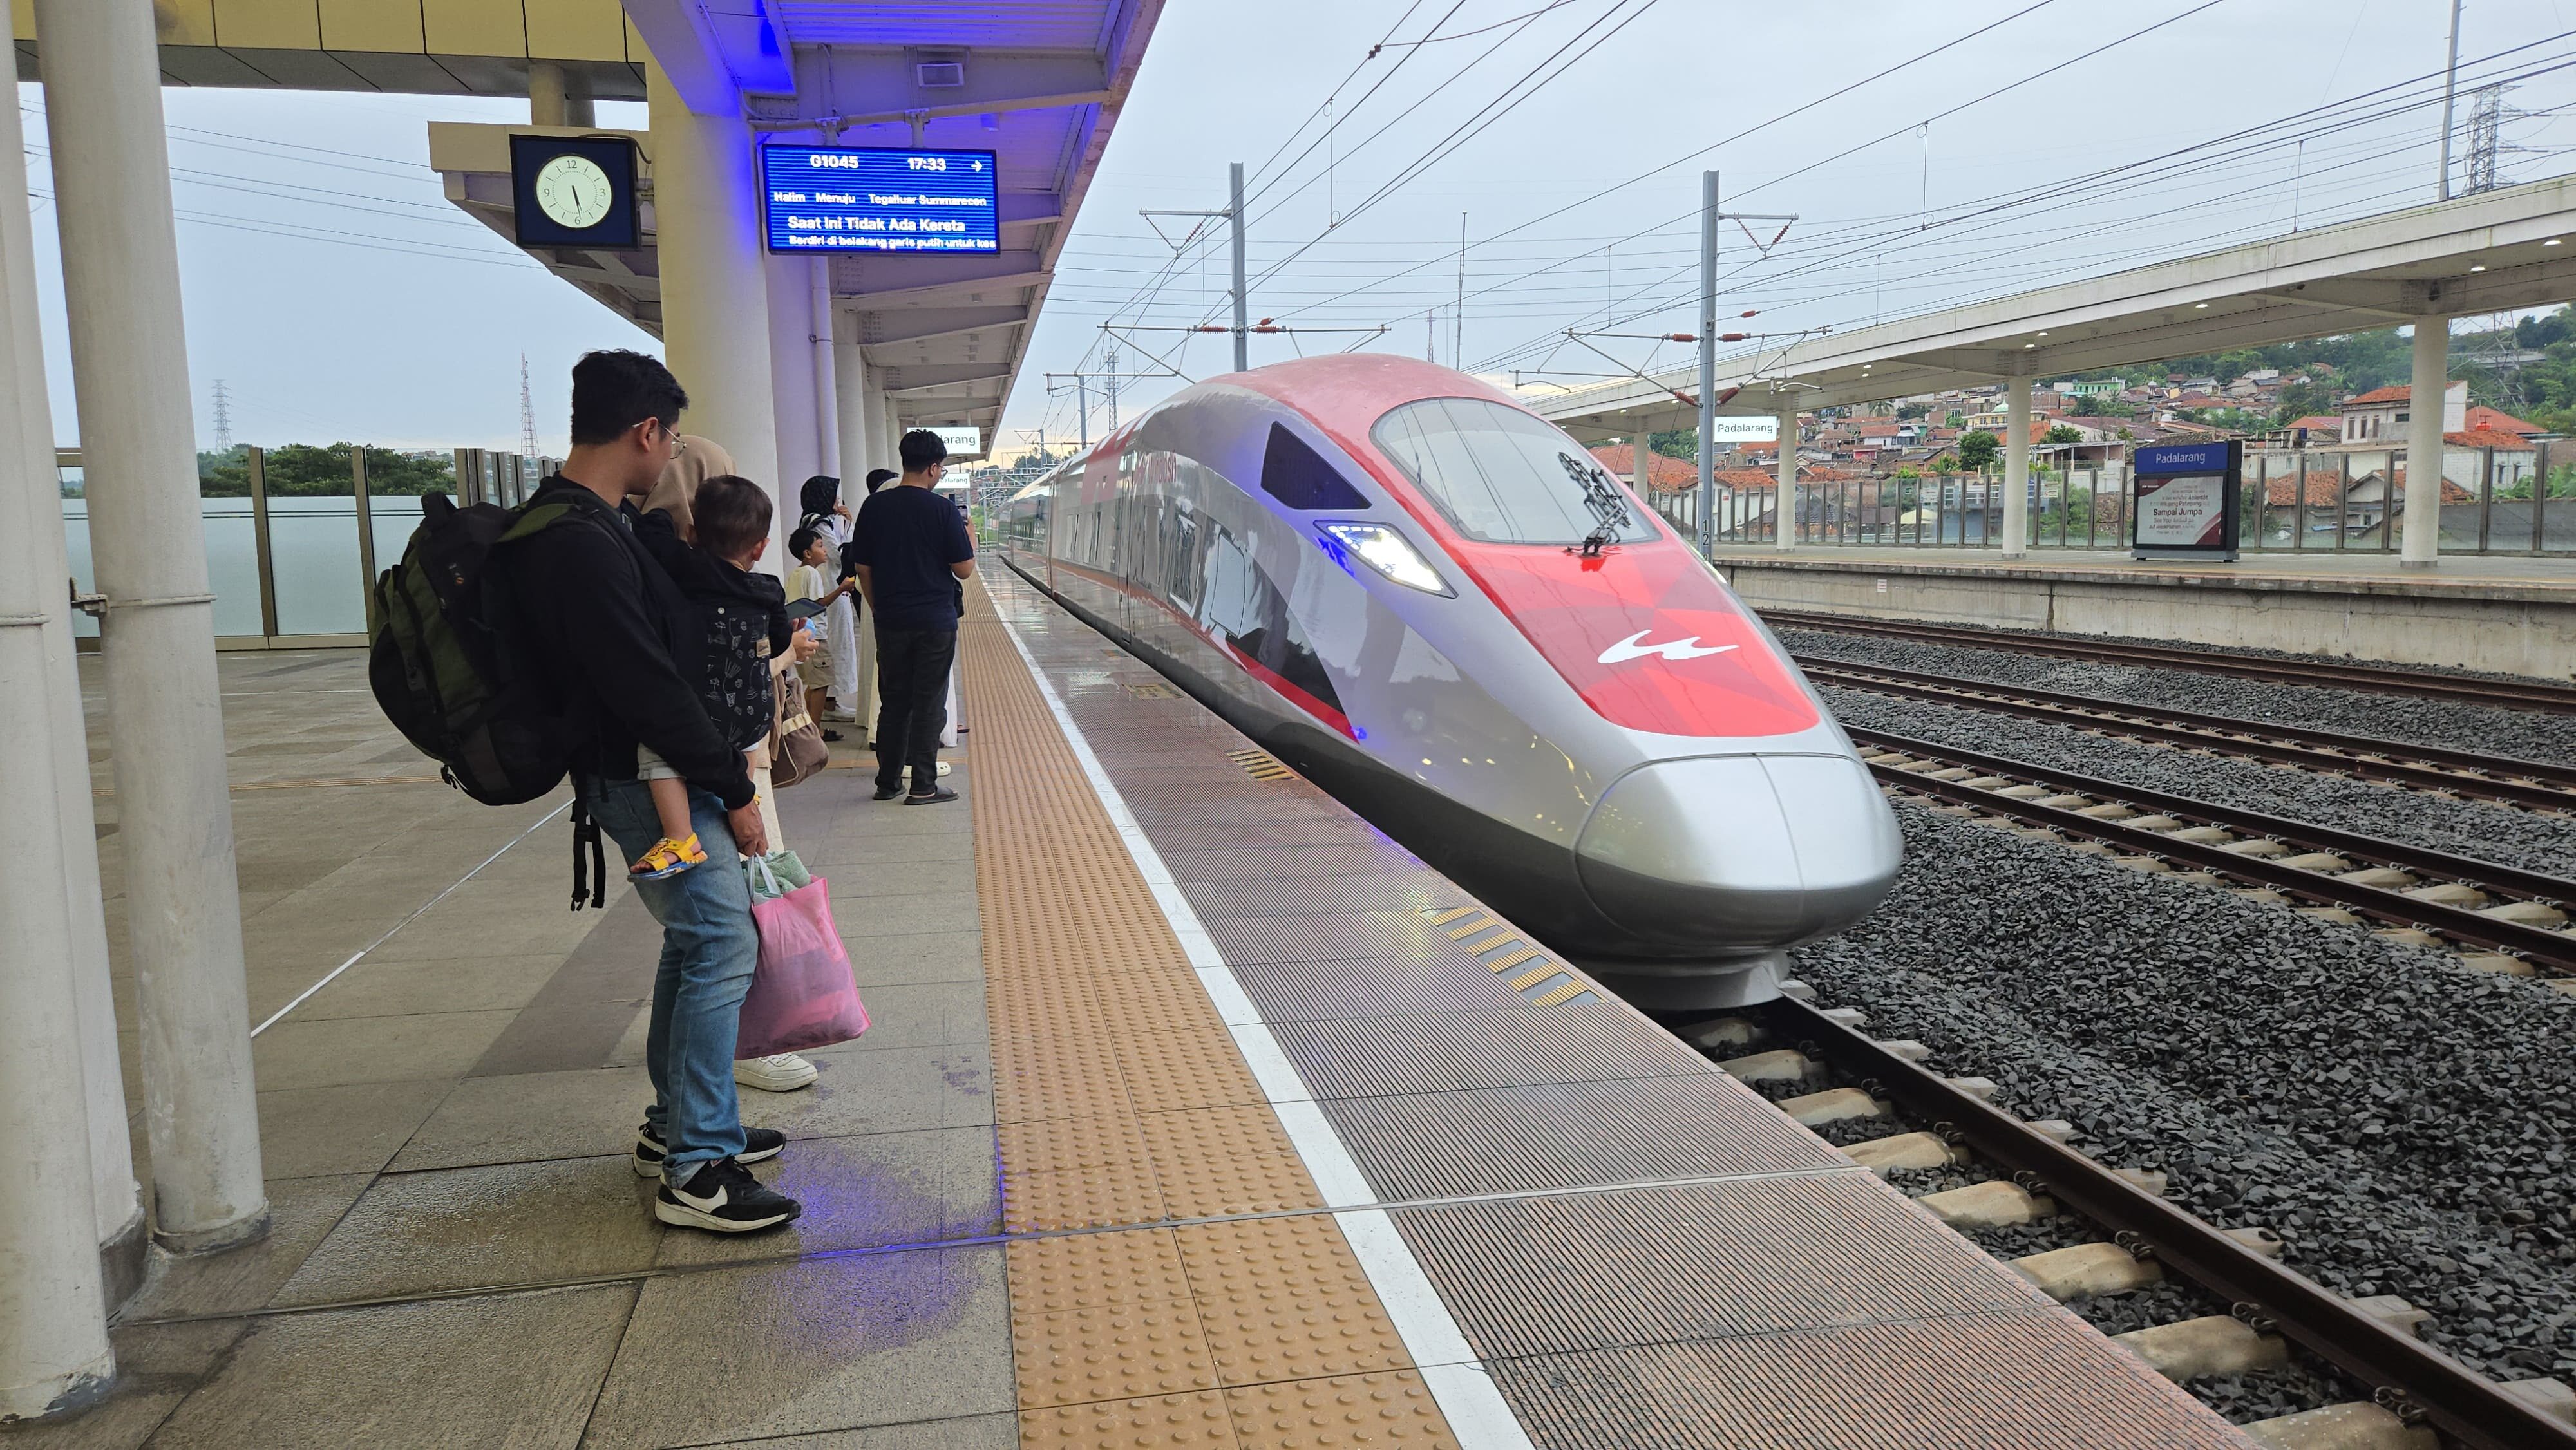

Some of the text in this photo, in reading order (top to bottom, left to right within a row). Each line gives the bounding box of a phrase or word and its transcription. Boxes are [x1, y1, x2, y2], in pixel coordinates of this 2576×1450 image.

[567, 160, 577, 169] 12
[810, 155, 947, 171] G1045 17:33
[544, 188, 550, 196] 9
[600, 188, 606, 196] 3
[774, 191, 987, 206] Halim Menuju Tegalluar Summarecon
[574, 216, 581, 225] 6
[788, 216, 966, 232] Saat Ini Tidak Ada Kereta
[788, 235, 825, 245] Berdiri
[827, 236, 837, 245] di
[838, 236, 887, 249] belakang
[889, 238, 916, 249] garis
[916, 238, 944, 250] putih
[945, 238, 976, 248] untuk
[1718, 424, 1773, 434] Padalarang
[2155, 452, 2206, 464] Padalarang
[2153, 507, 2202, 516] Sampai Jumpa
